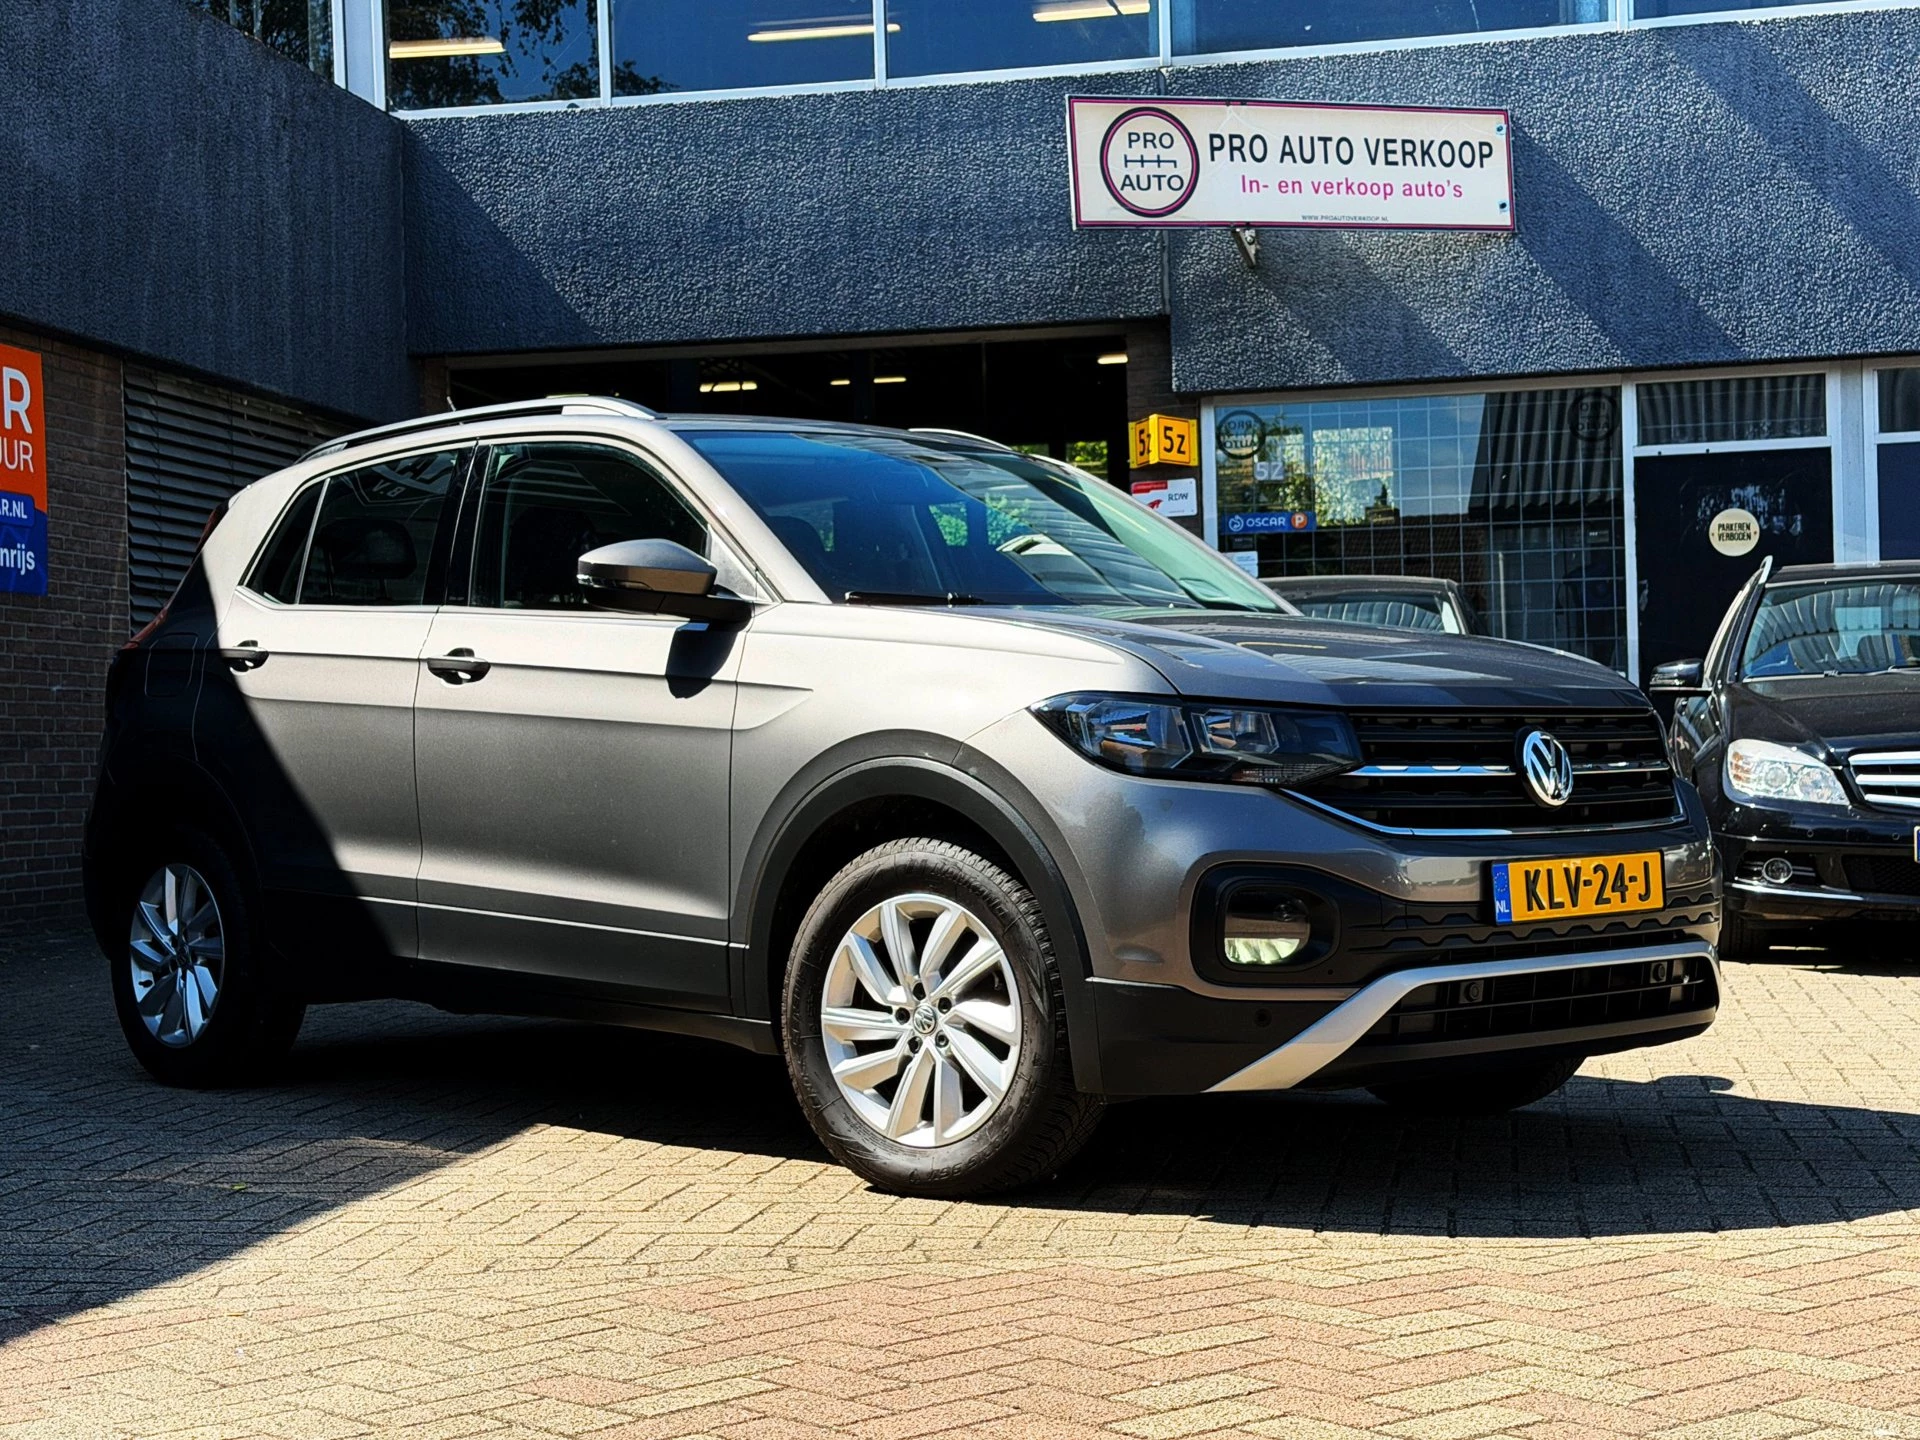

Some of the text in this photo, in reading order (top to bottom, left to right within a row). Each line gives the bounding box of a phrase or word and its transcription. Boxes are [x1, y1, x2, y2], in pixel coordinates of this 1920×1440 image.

[1127, 131, 1175, 150] PRO
[1208, 132, 1494, 169] PRO AUTO VERKOOP
[1120, 174, 1184, 192] AUTO
[1241, 174, 1463, 200] In- en verkoop auto's
[1168, 493, 1188, 501] RDW
[1246, 517, 1285, 527] OSCAR
[1717, 522, 1751, 534] PARKEREN
[1717, 532, 1752, 542] VERBODEN
[1524, 860, 1651, 912] KLV-24-J
[1496, 900, 1509, 913] NL
